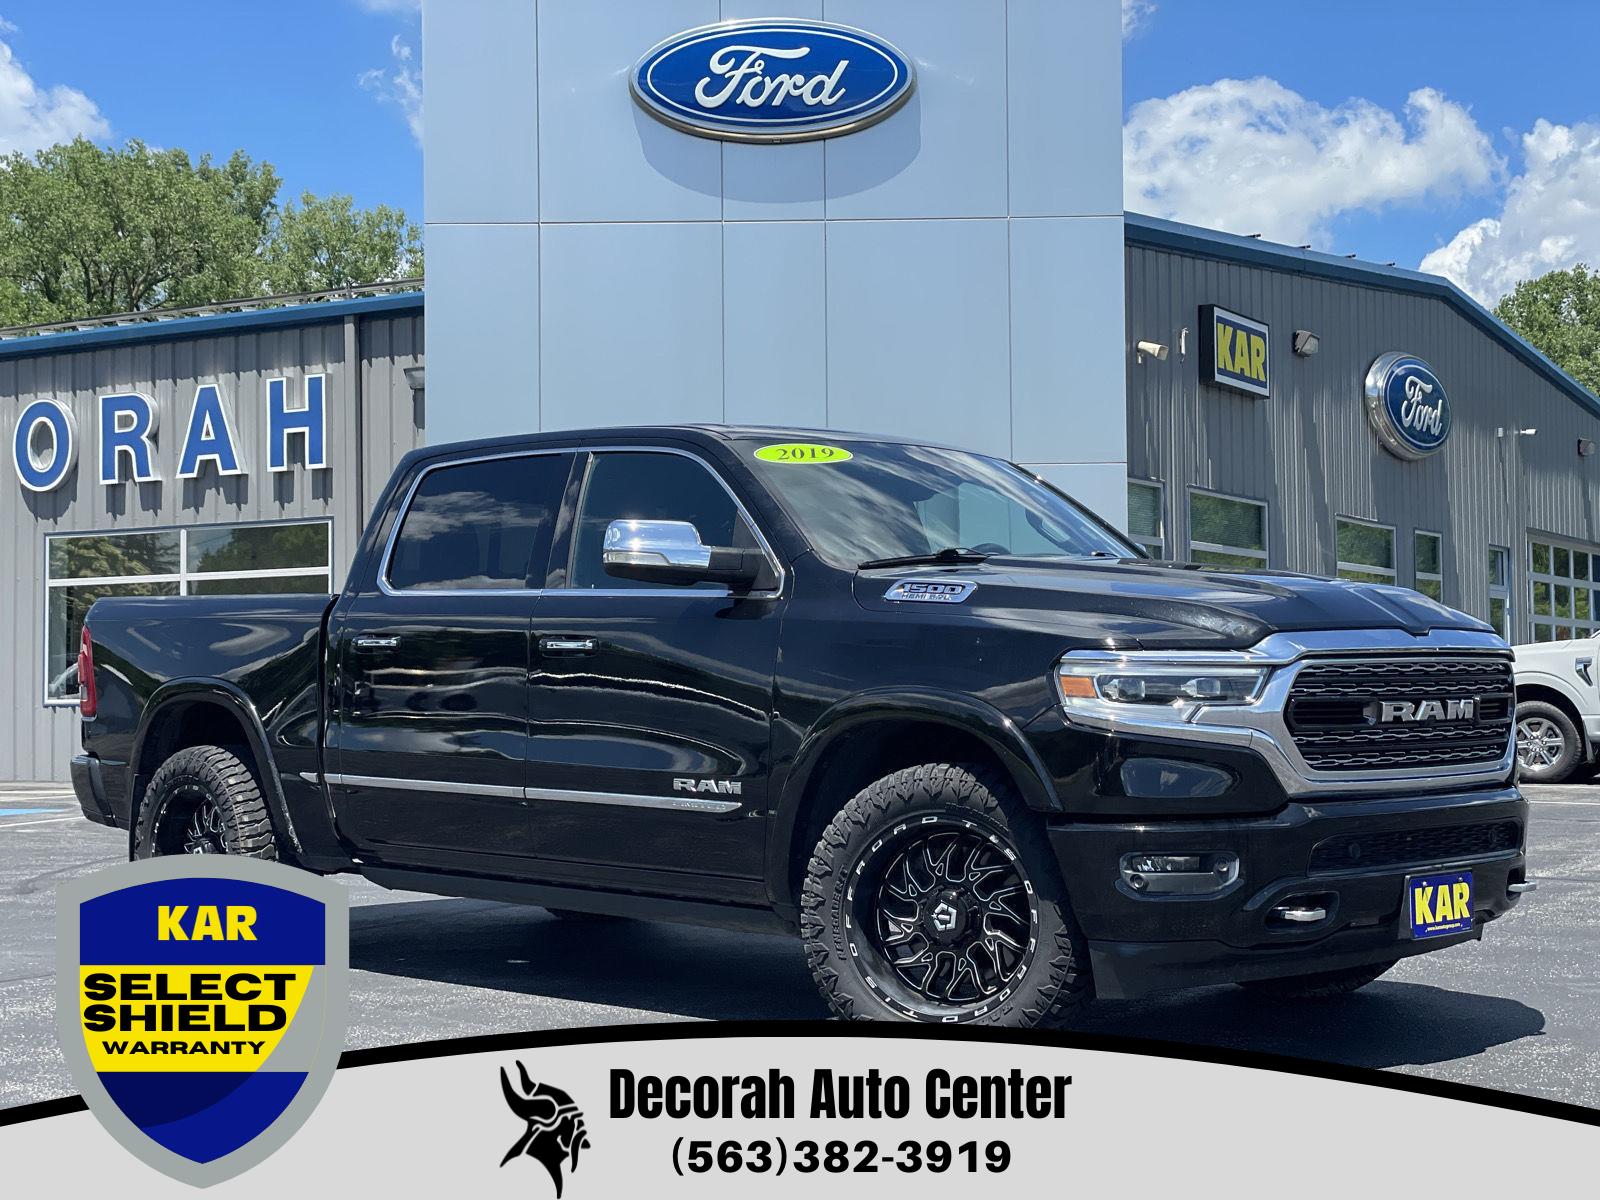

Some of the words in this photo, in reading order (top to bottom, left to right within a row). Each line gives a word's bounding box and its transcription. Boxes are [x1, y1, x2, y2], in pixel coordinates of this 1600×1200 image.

[694, 45, 849, 108] Ford
[1217, 323, 1266, 382] KAR
[1401, 376, 1442, 436] Ford
[13, 373, 330, 492] ORAH
[775, 447, 835, 460] 2019
[899, 582, 964, 595] 1500
[1380, 699, 1474, 722] RAM
[673, 778, 741, 794] RAM
[1415, 882, 1470, 925] KAR
